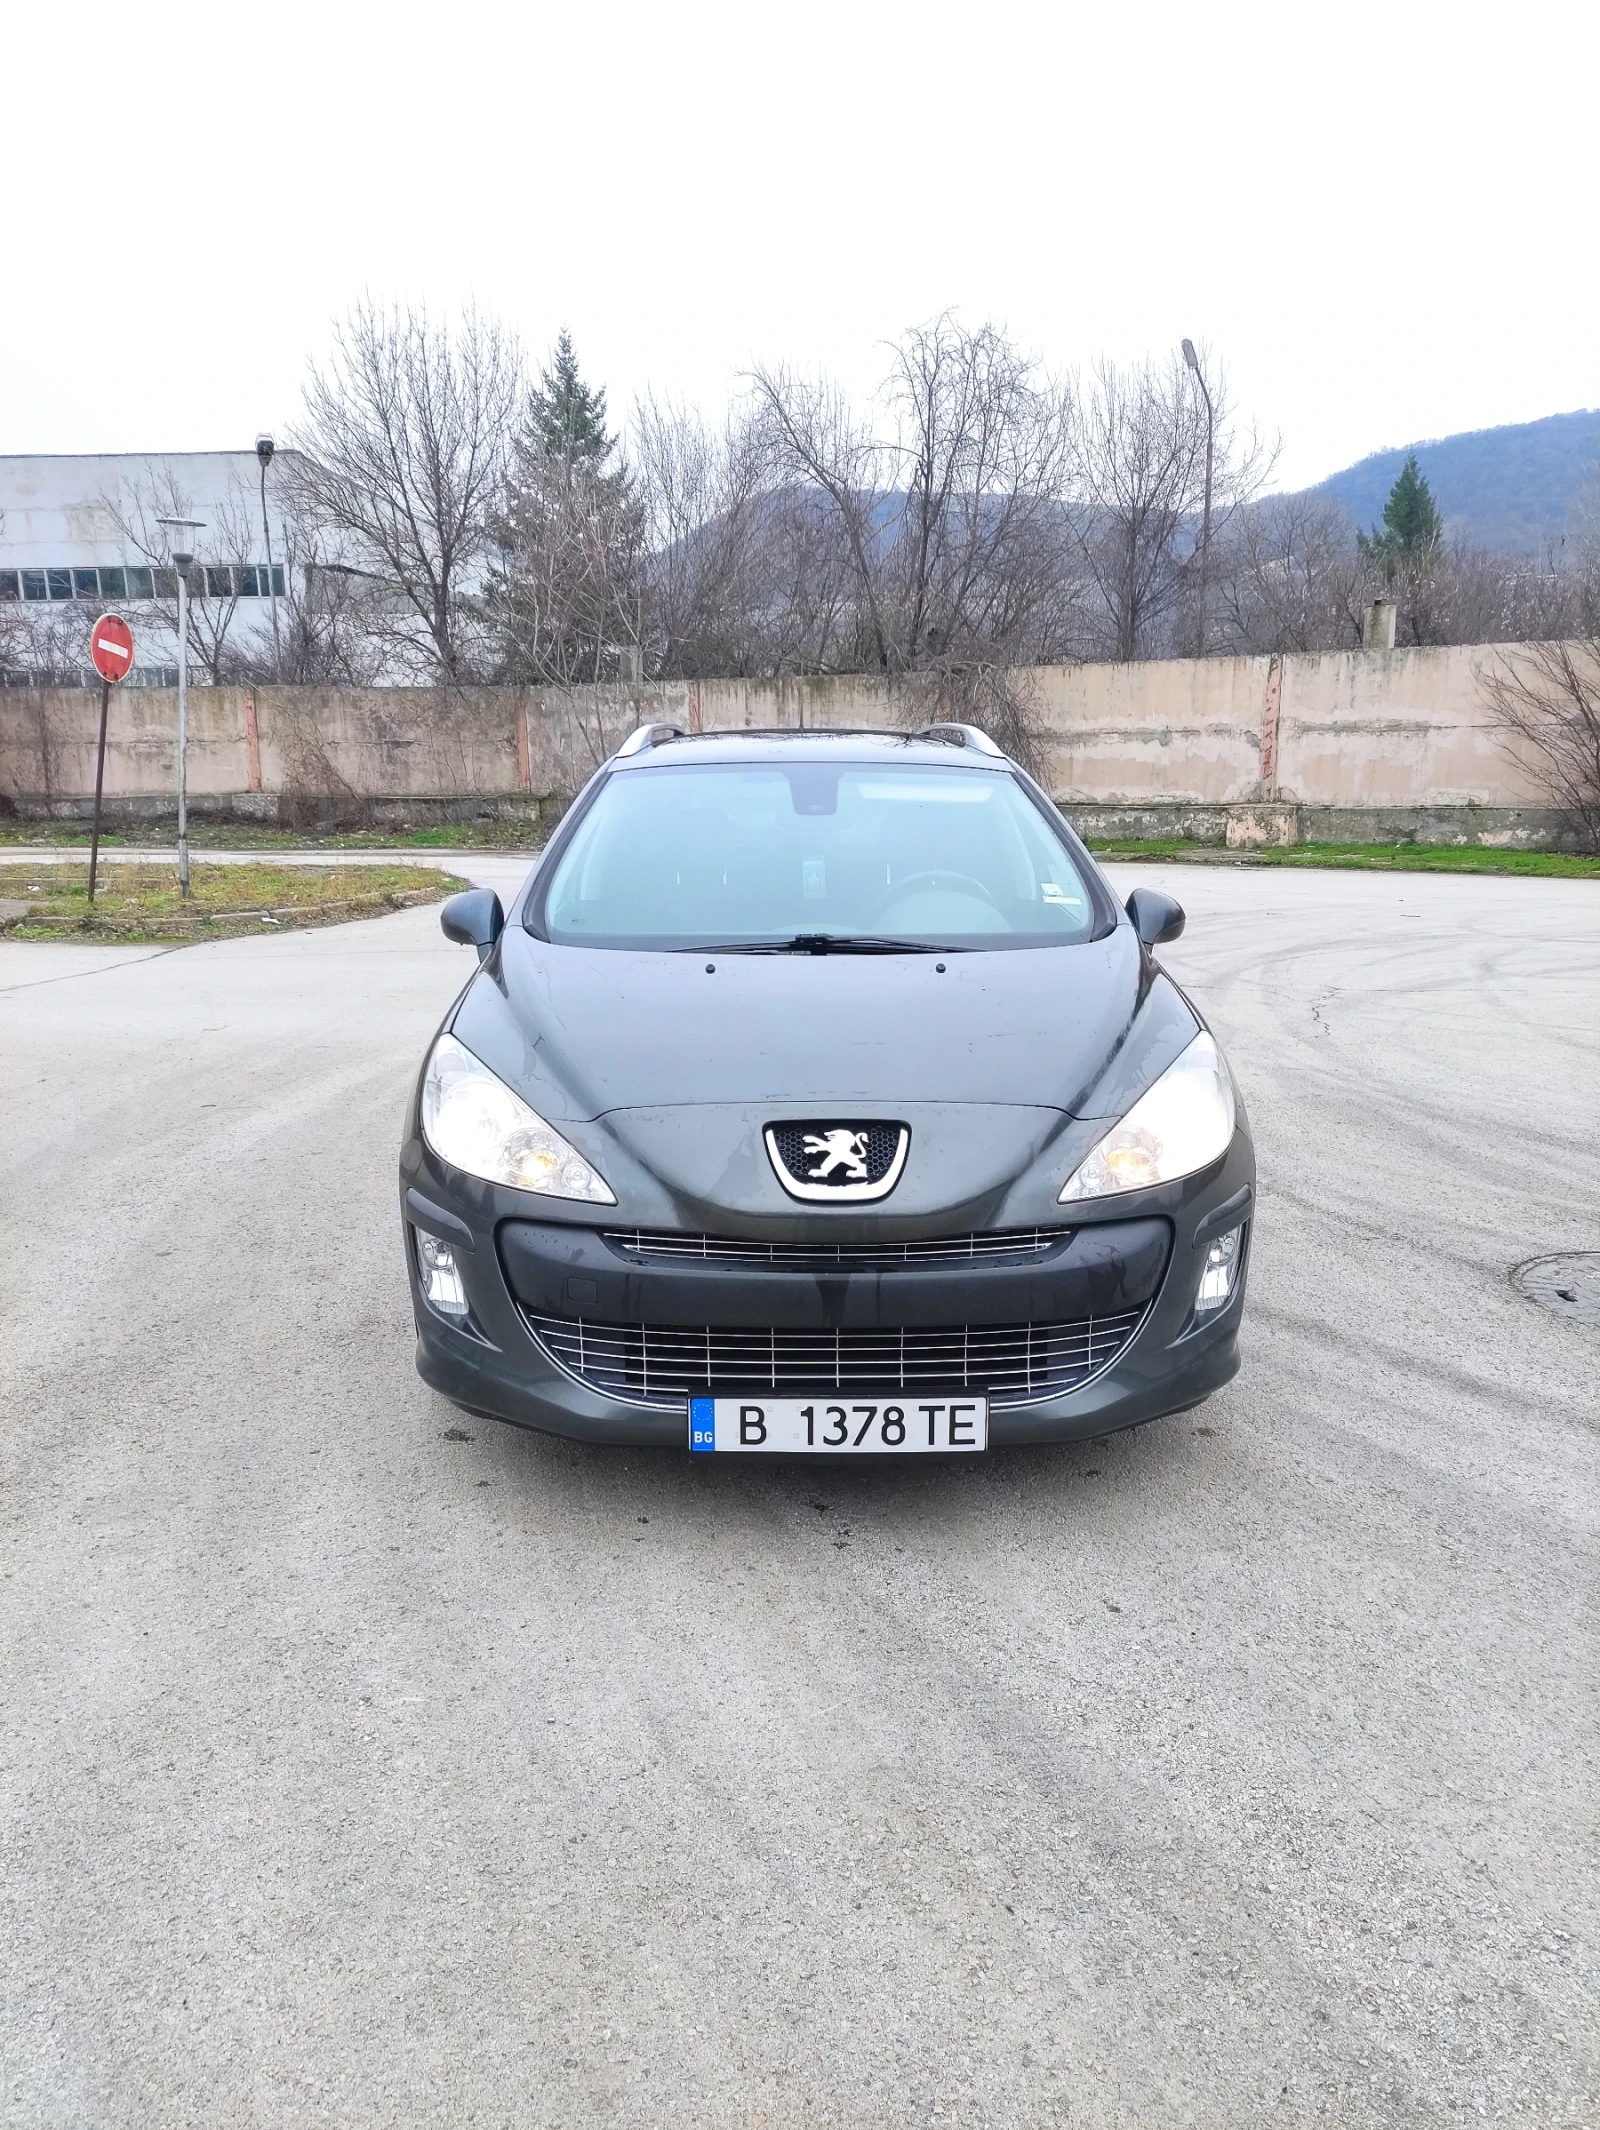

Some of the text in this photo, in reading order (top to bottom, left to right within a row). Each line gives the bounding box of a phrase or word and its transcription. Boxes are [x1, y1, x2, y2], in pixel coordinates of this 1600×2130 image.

[694, 1431, 713, 1444] BG
[739, 1404, 976, 1447] B 1378 TE
